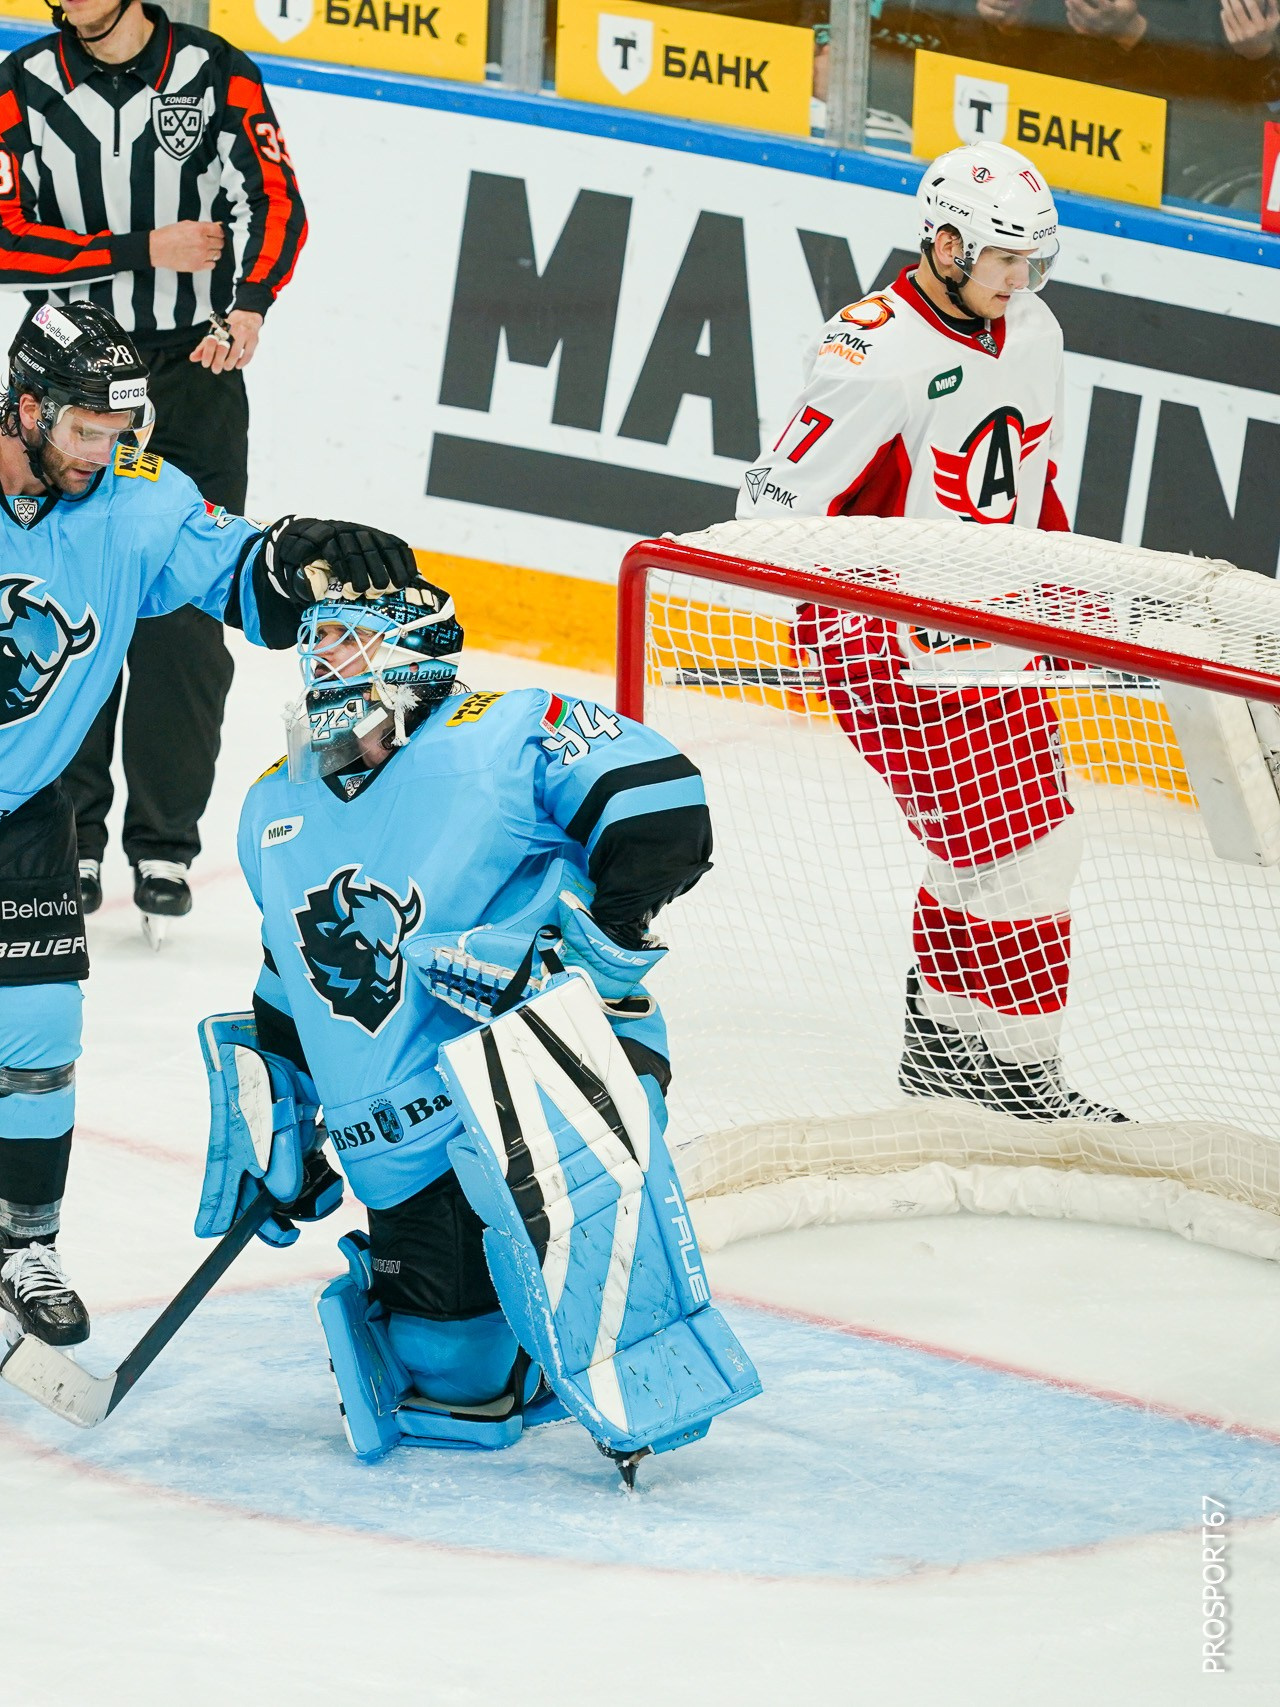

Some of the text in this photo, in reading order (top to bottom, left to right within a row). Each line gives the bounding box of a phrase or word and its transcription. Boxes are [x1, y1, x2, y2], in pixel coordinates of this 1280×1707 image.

[324, 0, 440, 40] БАНК
[663, 45, 770, 93] БАНК
[165, 96, 197, 105] FONBET
[1017, 110, 1123, 163] БАНК
[1019, 170, 1041, 193] 17
[939, 200, 970, 217] CCM
[45, 321, 71, 346] belbet
[106, 344, 134, 367] 28
[111, 387, 145, 401] согаз
[934, 375, 958, 392] МИР
[773, 402, 835, 464] 7
[763, 483, 798, 508] РМК
[541, 700, 623, 766] 94
[268, 824, 293, 840] МИР
[1, 893, 78, 920] Belavia
[329, 1094, 453, 1151] BSB Ba
[664, 1178, 710, 1304] TRUE
